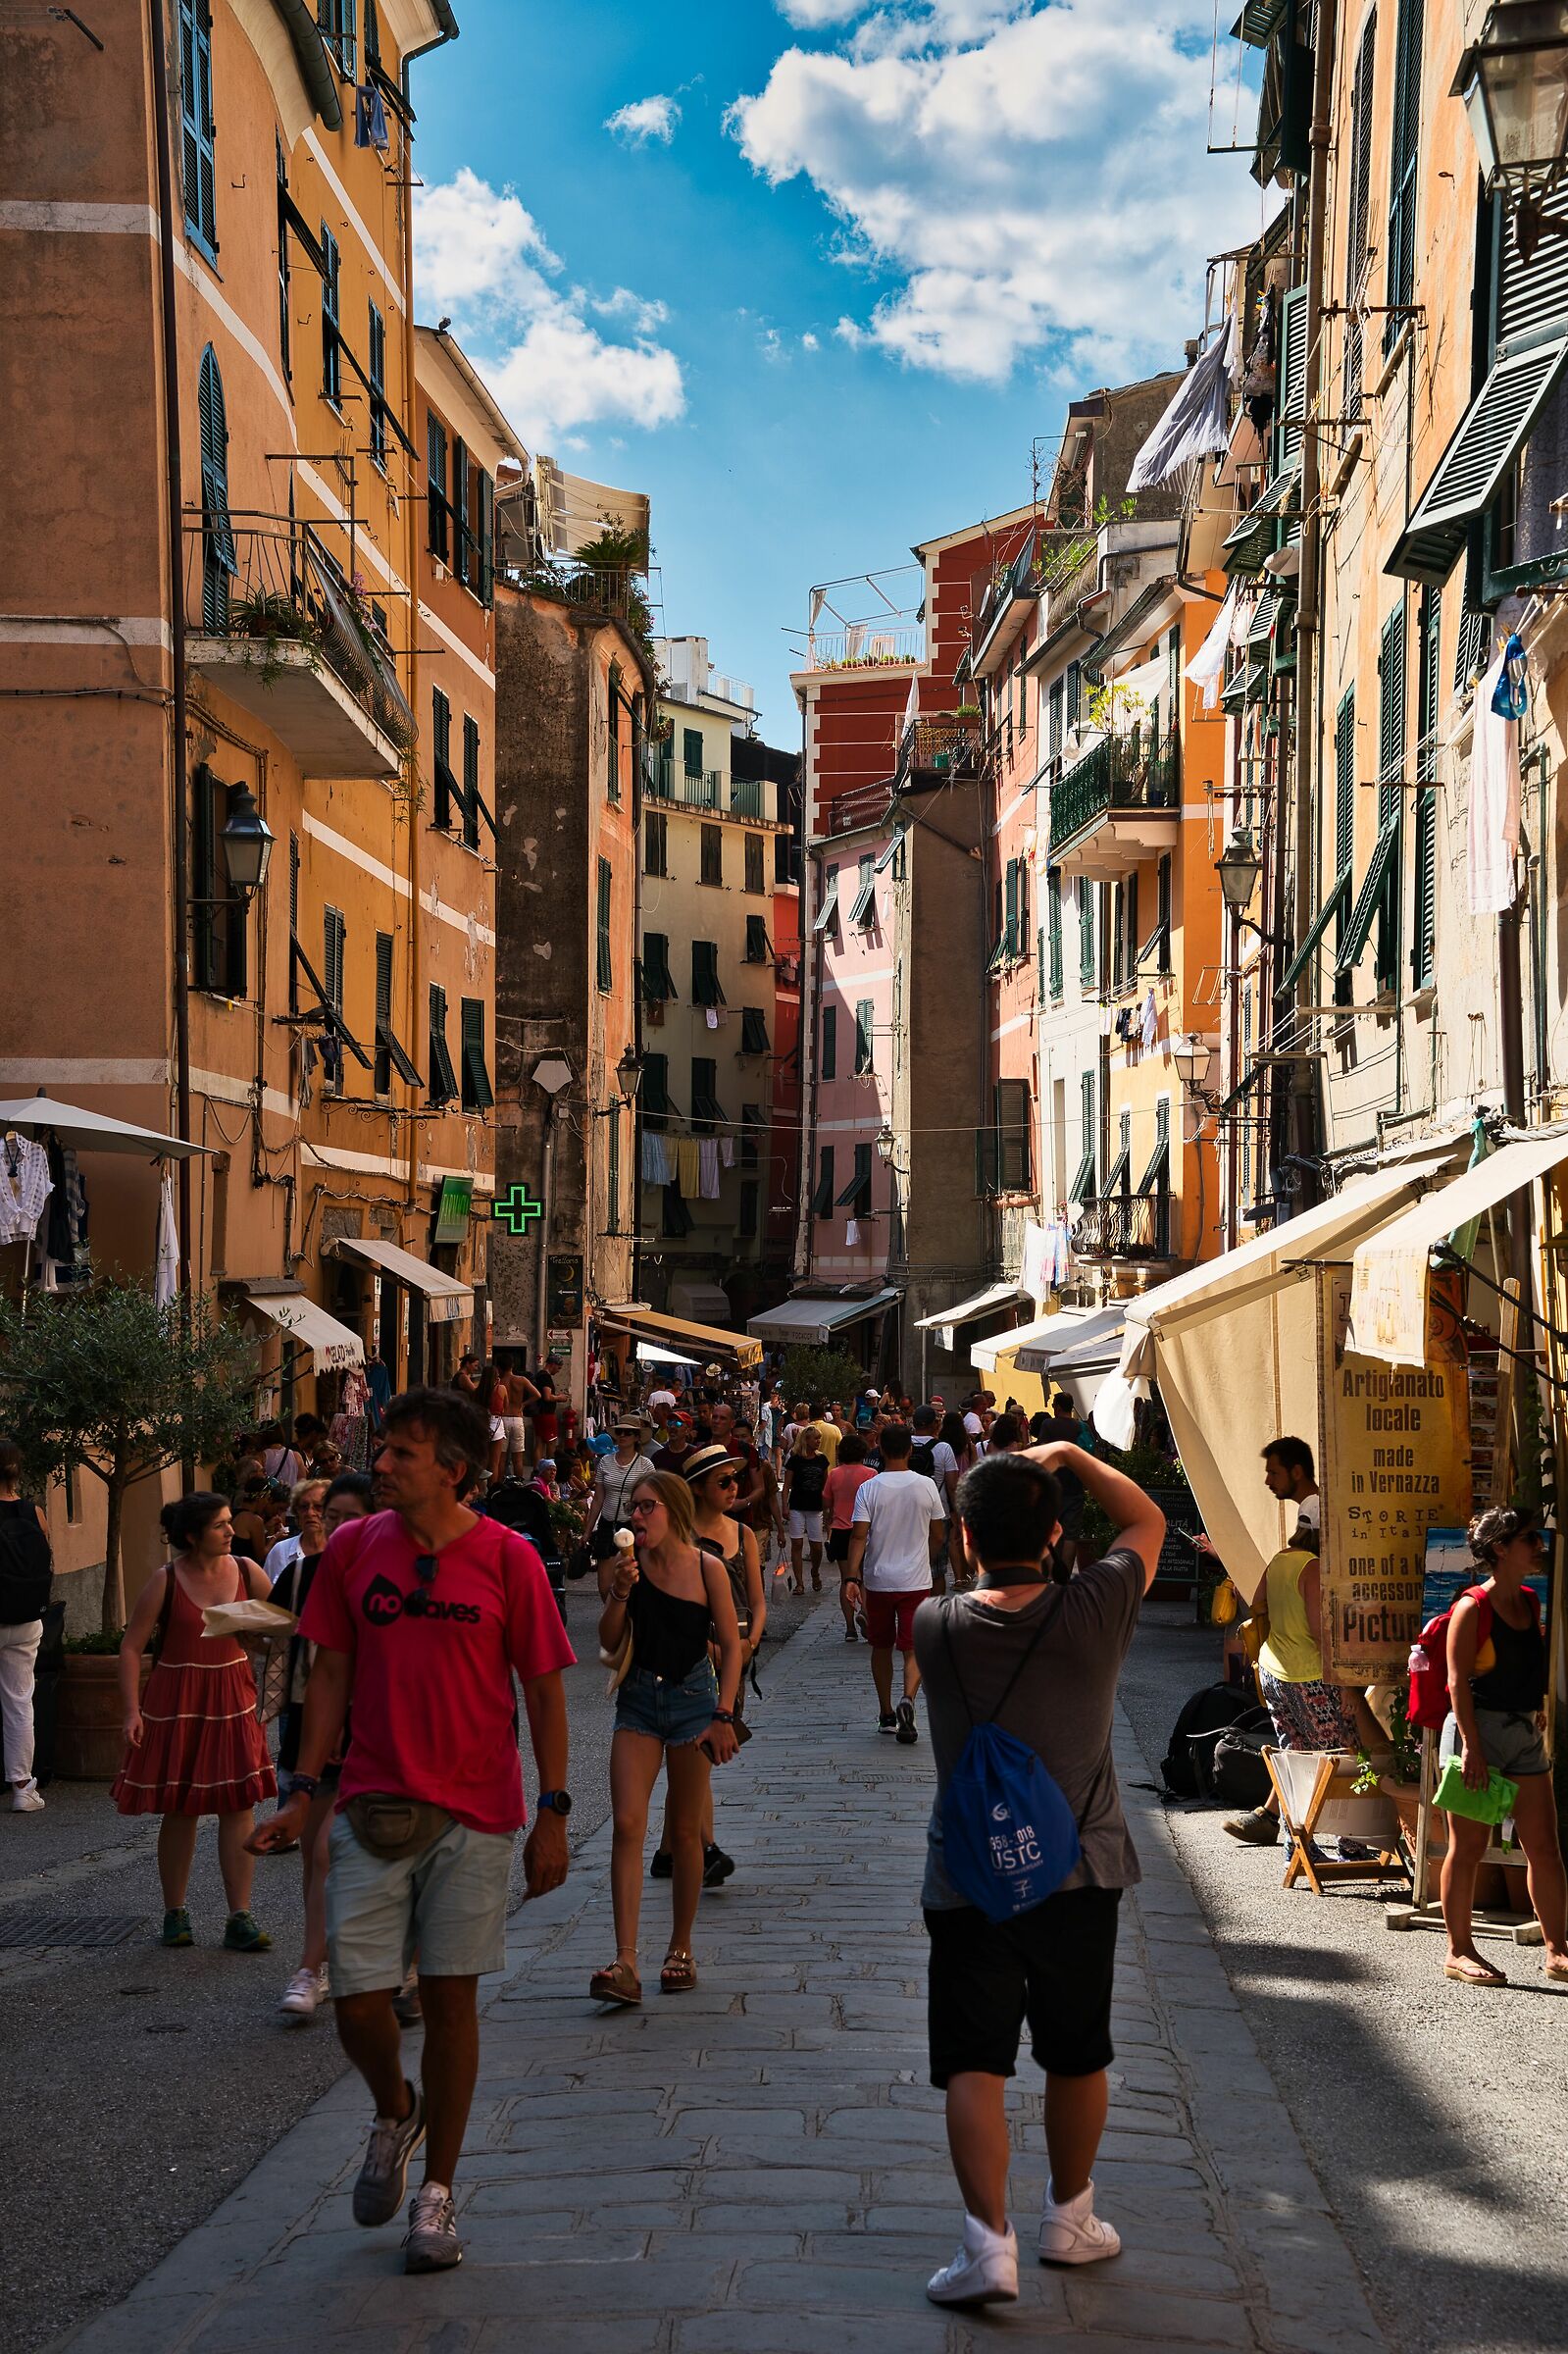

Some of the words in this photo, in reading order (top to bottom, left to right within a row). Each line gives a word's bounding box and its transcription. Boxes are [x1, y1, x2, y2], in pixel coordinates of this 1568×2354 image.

[1342, 1369, 1444, 1402] Artigianato
[1366, 1403, 1421, 1432] locale
[1373, 1445, 1413, 1467] made
[1351, 1471, 1364, 1493] in
[1369, 1471, 1440, 1494] Vernazza
[1351, 1528, 1367, 1540] in
[1380, 1525, 1423, 1539] Ital
[1348, 1557, 1375, 1576] one
[1381, 1554, 1395, 1576] of
[1399, 1558, 1408, 1576] a
[1352, 1581, 1423, 1602] accessor
[369, 1593, 402, 1615] no
[406, 1600, 481, 1624] aves
[1343, 1604, 1421, 1643] Pictur
[990, 1841, 1041, 1869] USTC
